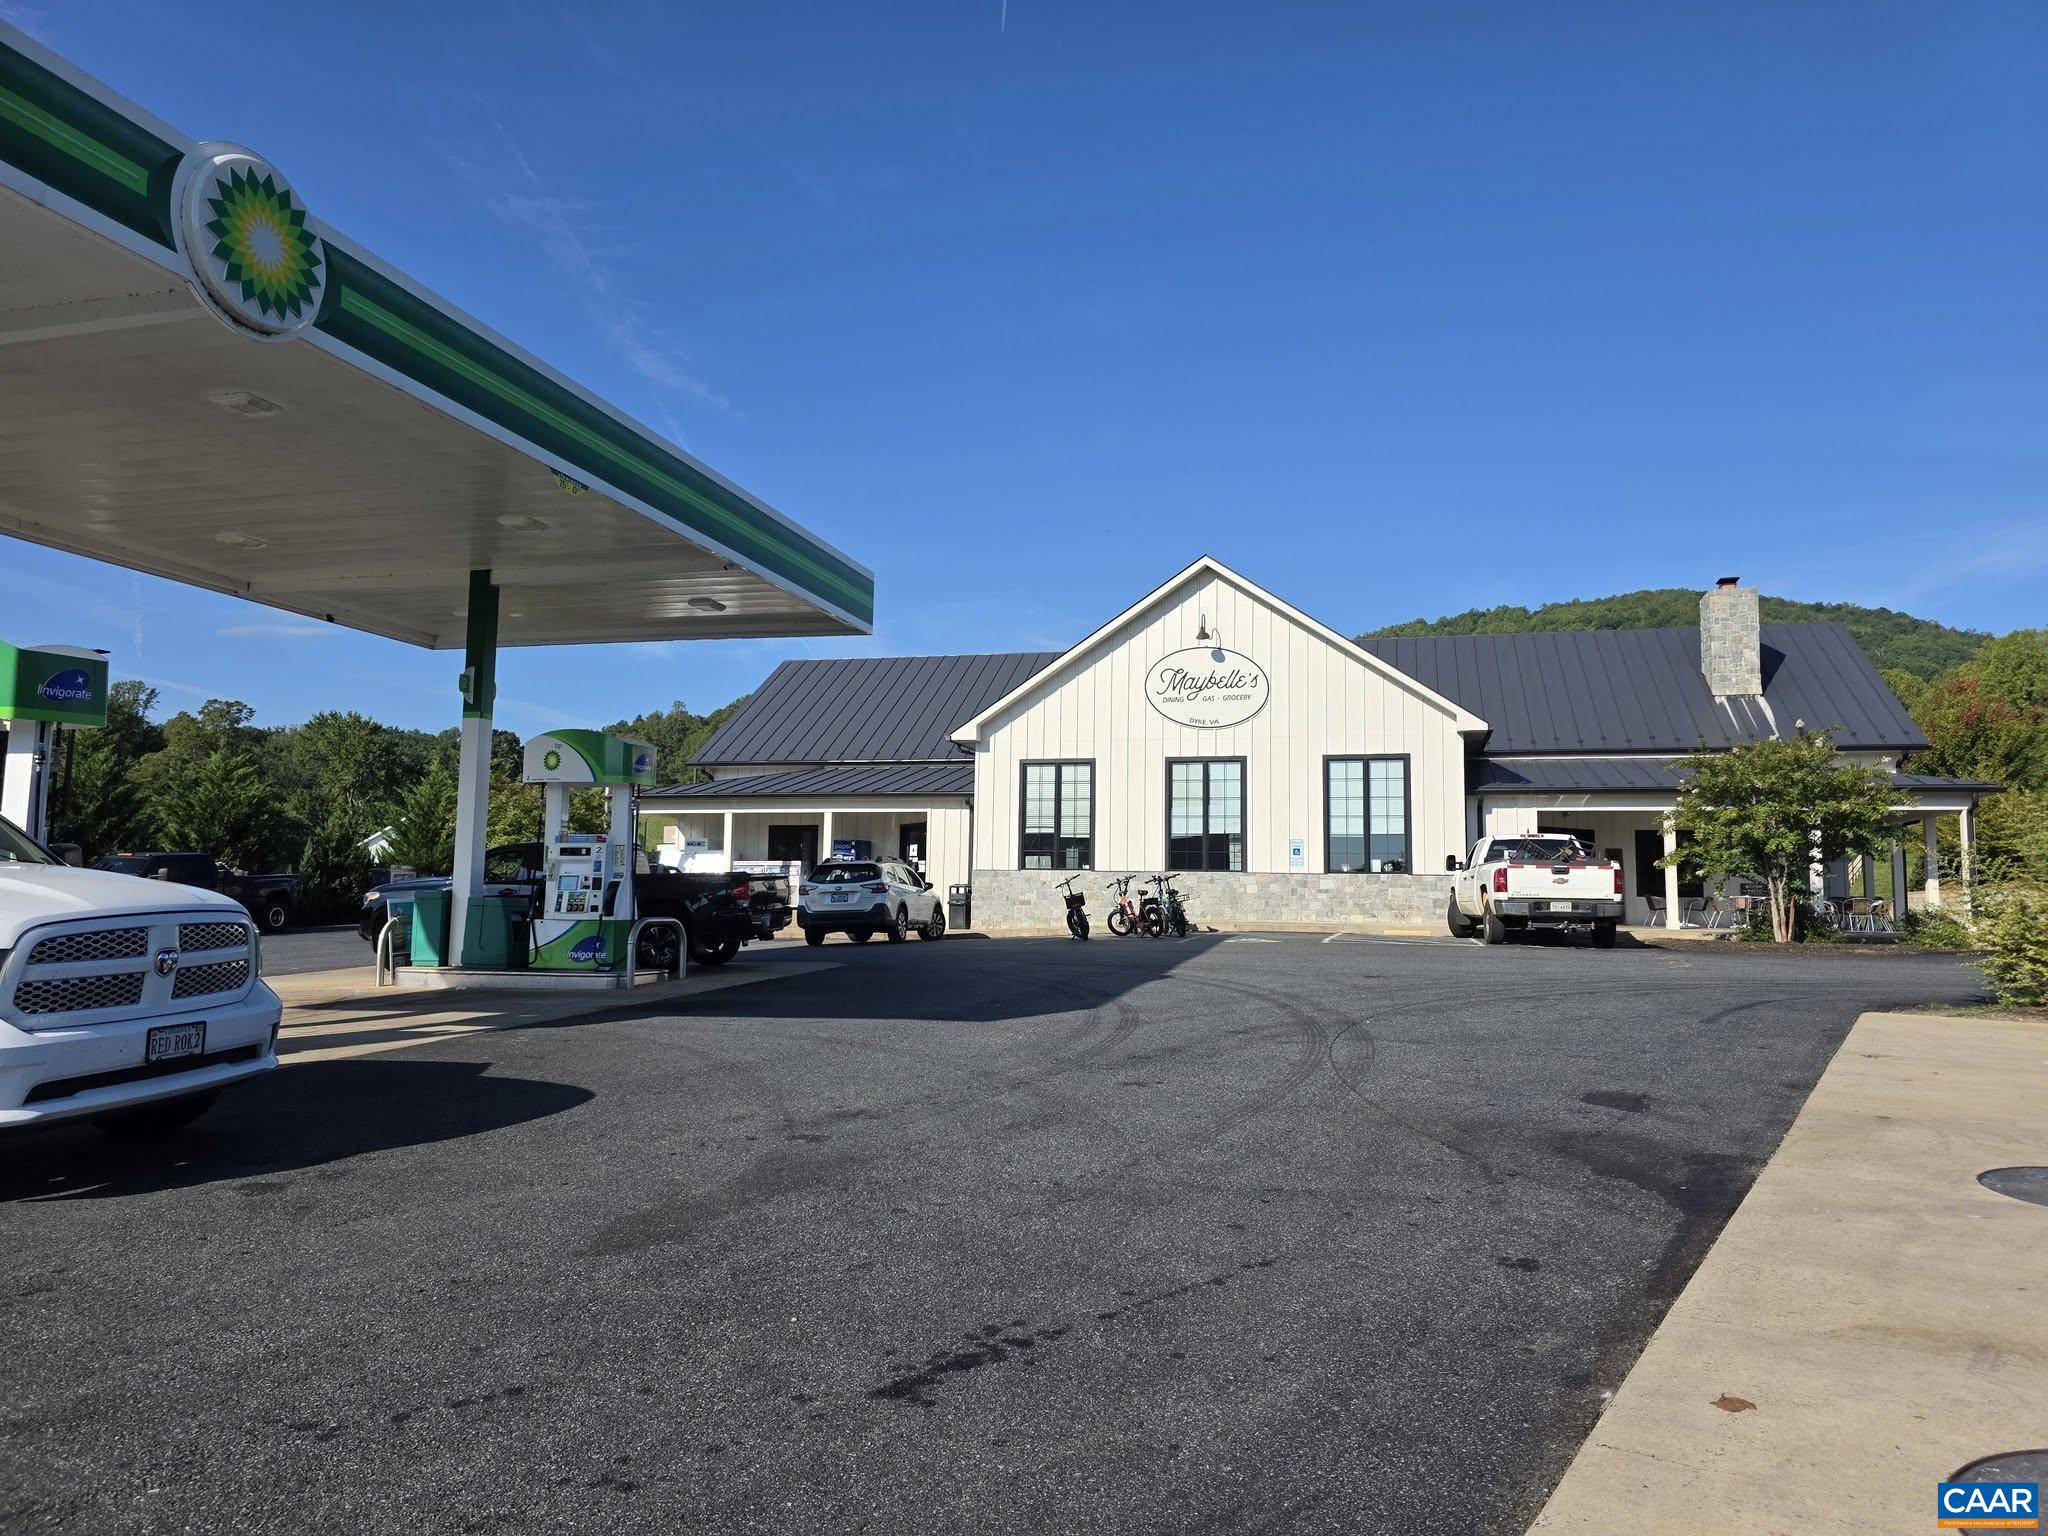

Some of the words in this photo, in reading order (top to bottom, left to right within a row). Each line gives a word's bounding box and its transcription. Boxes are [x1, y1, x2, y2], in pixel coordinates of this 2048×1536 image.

[37, 683, 92, 699] Invigorate
[1156, 668, 1259, 701] Maybelle's
[151, 1037, 171, 1055] RED
[174, 1032, 201, 1051] ROK2
